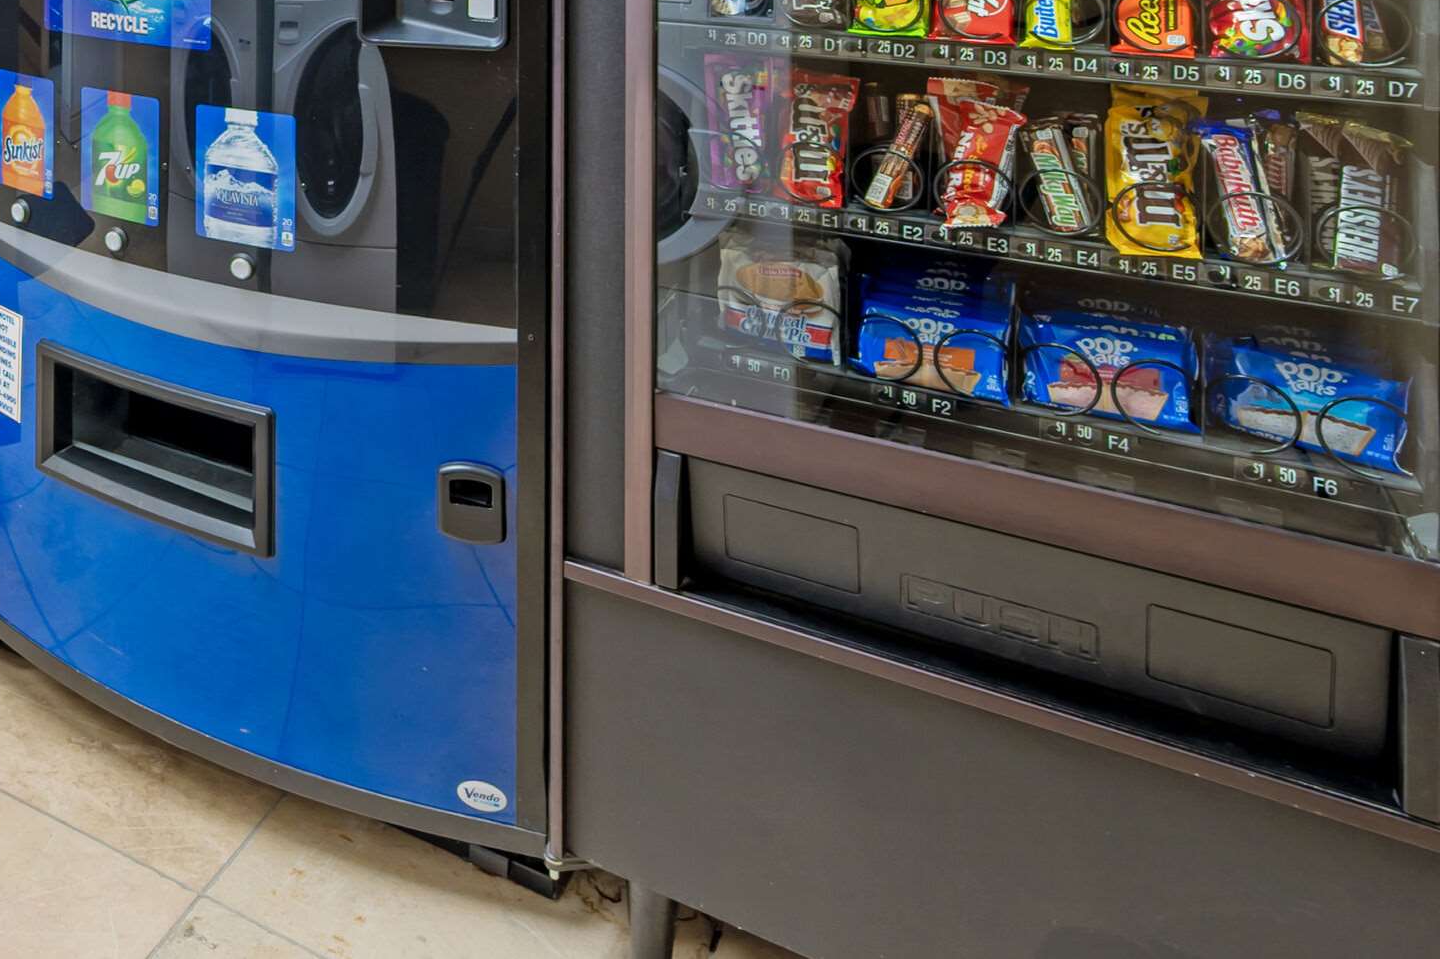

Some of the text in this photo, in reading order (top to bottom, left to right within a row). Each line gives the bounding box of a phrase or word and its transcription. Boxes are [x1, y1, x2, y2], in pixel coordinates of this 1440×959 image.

[91, 11, 149, 35] RECYCLE
[748, 32, 767, 46] D0
[893, 44, 915, 58] D2
[984, 51, 1007, 66] D3
[1074, 57, 1098, 73] D4
[1173, 65, 1200, 81] D5
[1277, 73, 1306, 90] D6
[1388, 81, 1418, 98] D7
[4, 137, 44, 163] Sunkist
[749, 203, 767, 217] E0
[821, 214, 838, 228] E1
[903, 226, 923, 241] E2
[987, 237, 1008, 253] E3
[1076, 250, 1099, 267] E4
[1172, 264, 1196, 281] E5
[1274, 278, 1301, 296] E6
[1391, 295, 1419, 314] E7
[773, 366, 790, 381] F0
[931, 399, 952, 416] F2
[1108, 435, 1130, 452] F4
[1313, 476, 1338, 496] F6
[464, 786, 501, 803] Vendo
